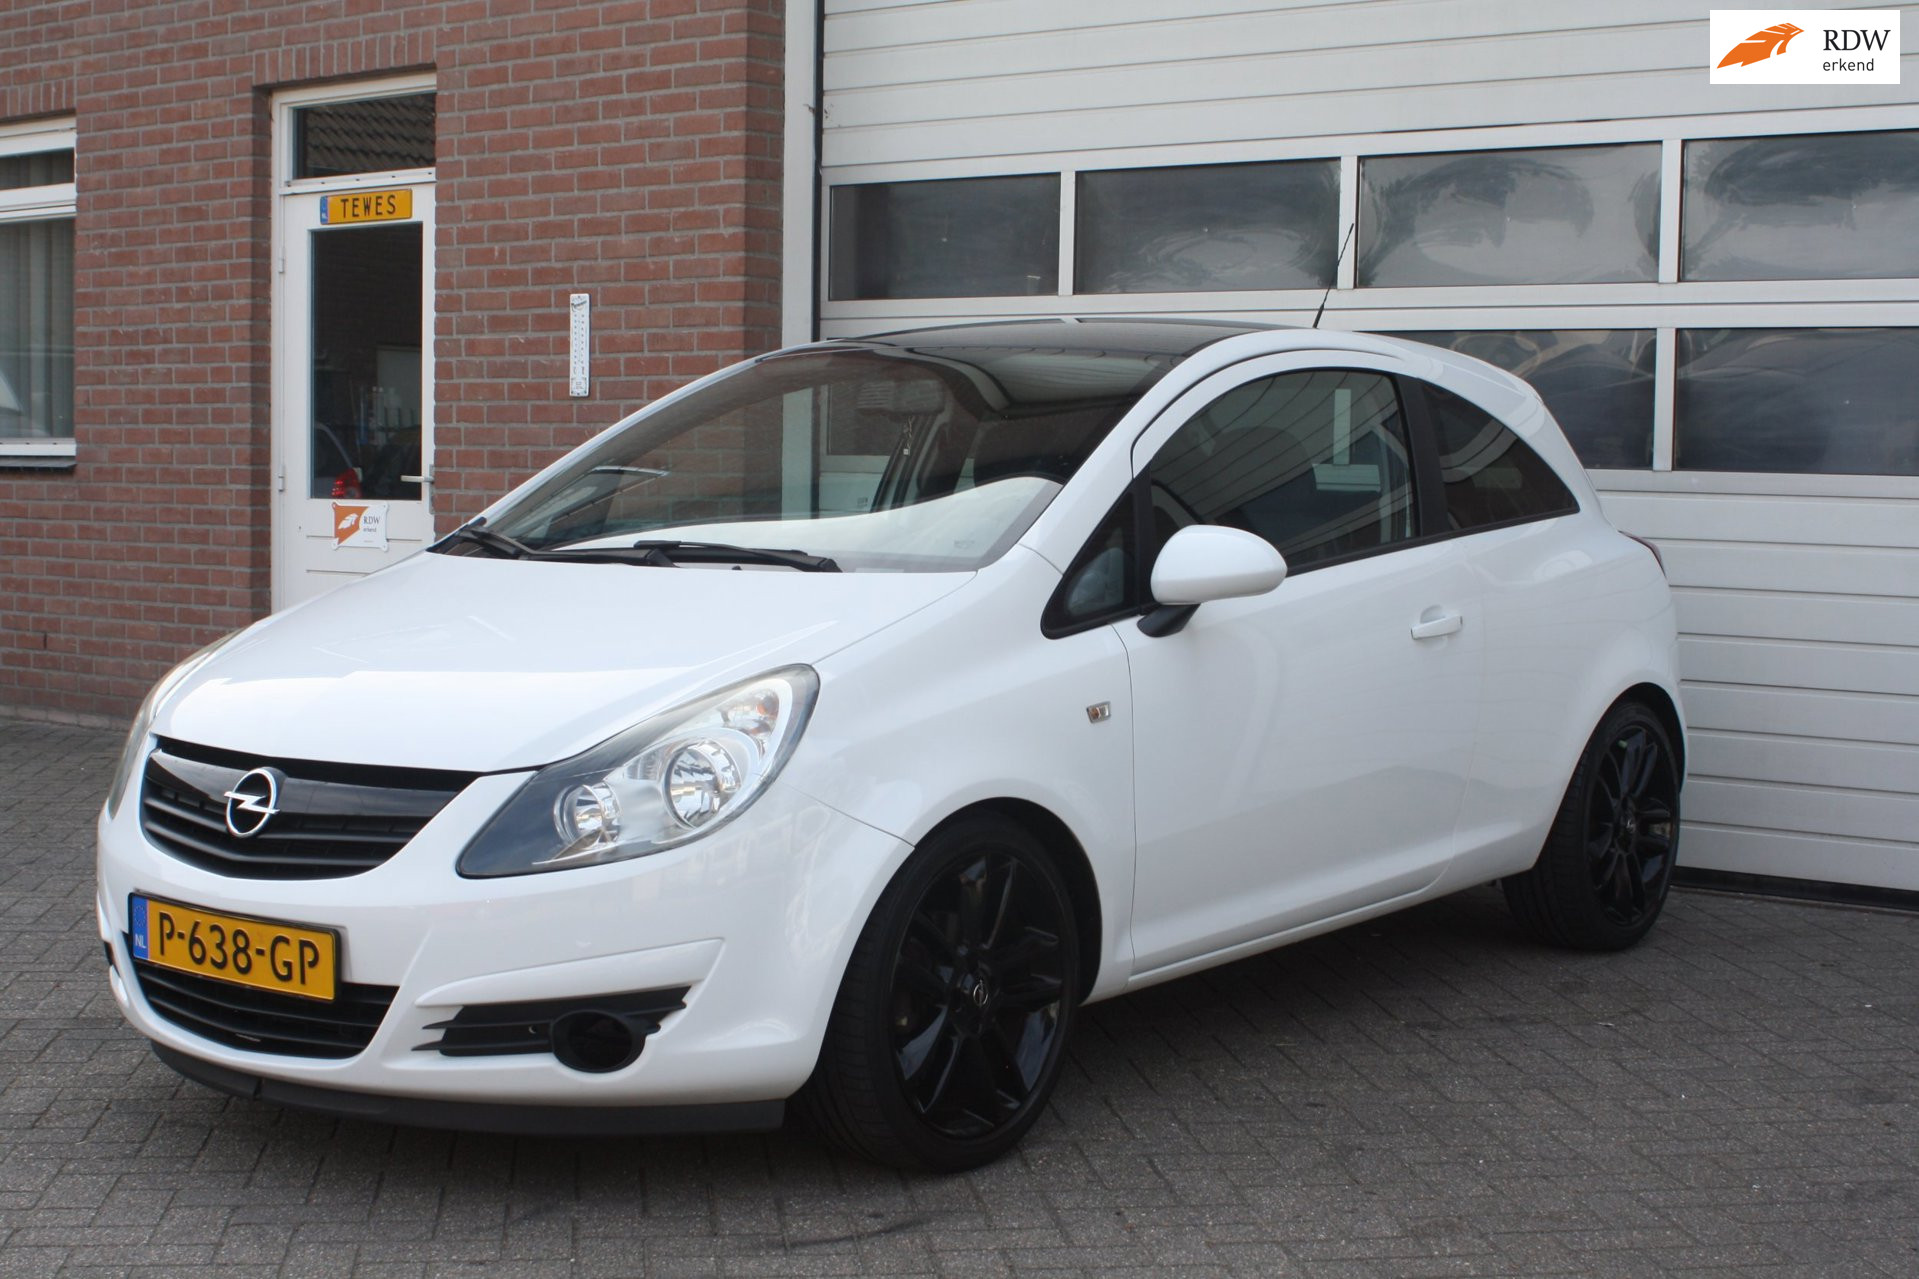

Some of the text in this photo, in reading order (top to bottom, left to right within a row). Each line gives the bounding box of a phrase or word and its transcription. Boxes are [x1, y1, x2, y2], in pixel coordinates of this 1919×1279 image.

[340, 194, 397, 219] TEWES
[363, 515, 380, 525] RDW
[135, 933, 147, 949] NL
[158, 911, 320, 985] P-638-GP
